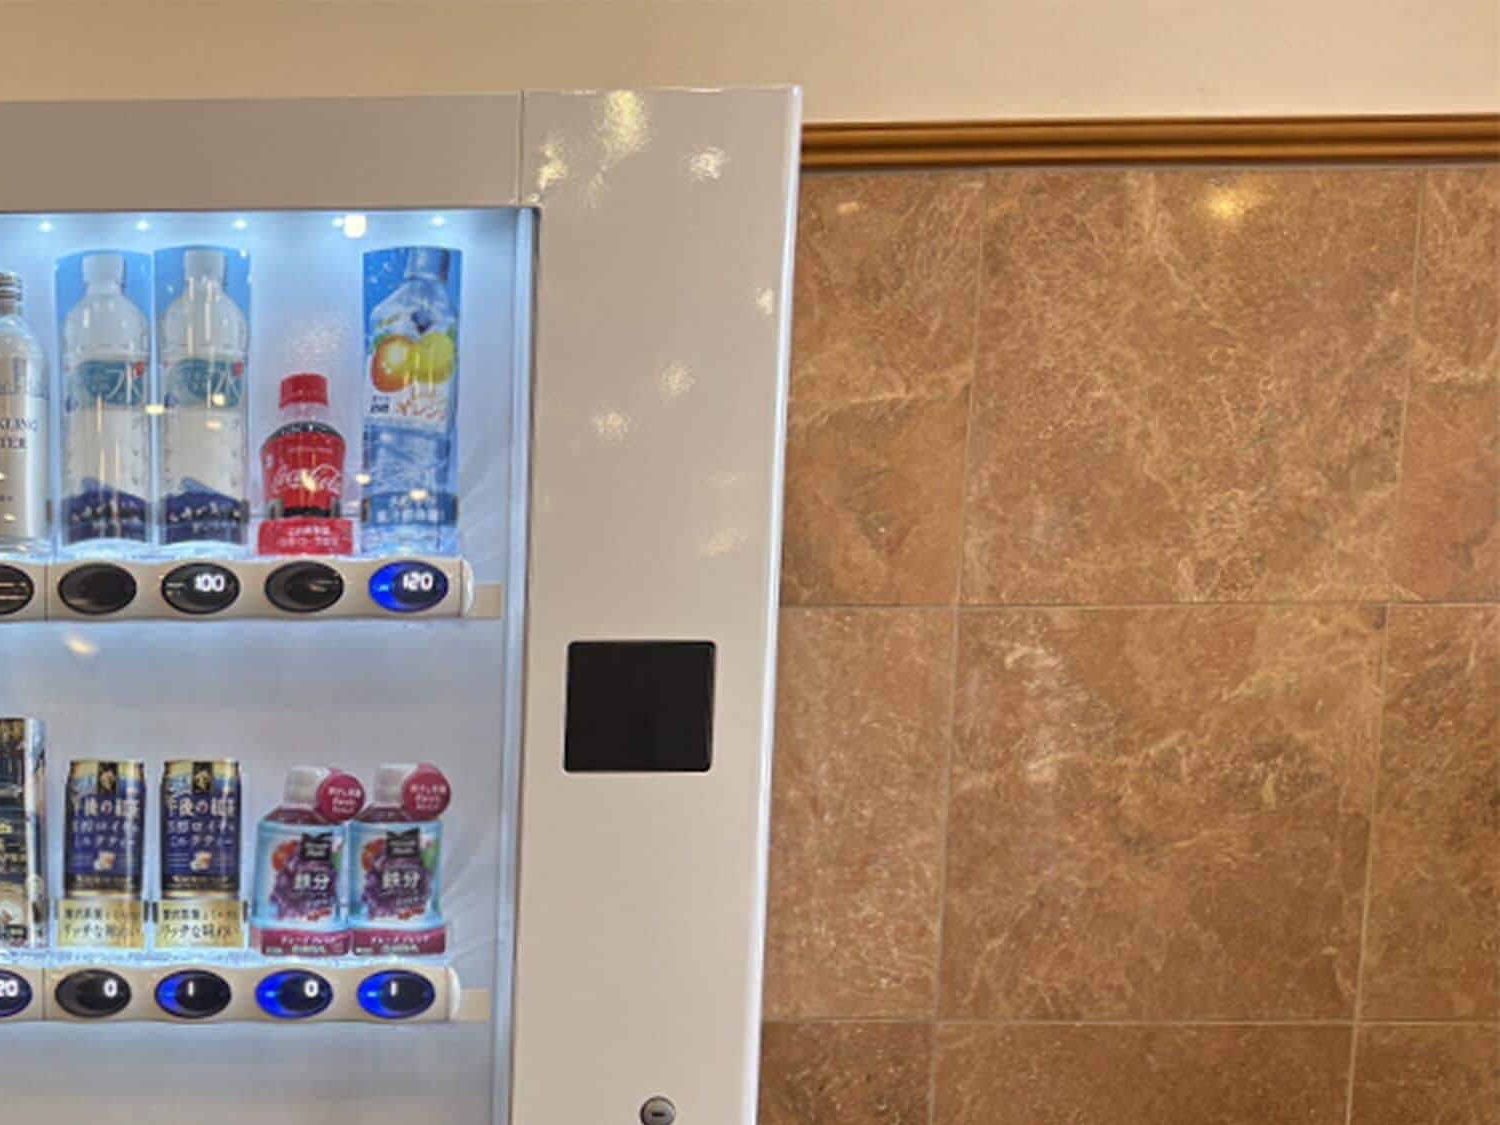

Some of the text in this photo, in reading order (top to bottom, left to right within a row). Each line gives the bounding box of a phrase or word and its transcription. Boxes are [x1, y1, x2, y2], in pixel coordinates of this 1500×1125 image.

[194, 572, 225, 592] 100
[403, 572, 434, 591] 120
[72, 797, 141, 818] 午後の紅茶
[166, 797, 236, 818] 午後の紅茶
[294, 872, 330, 890] 鉄分
[381, 871, 421, 889] 鉄分
